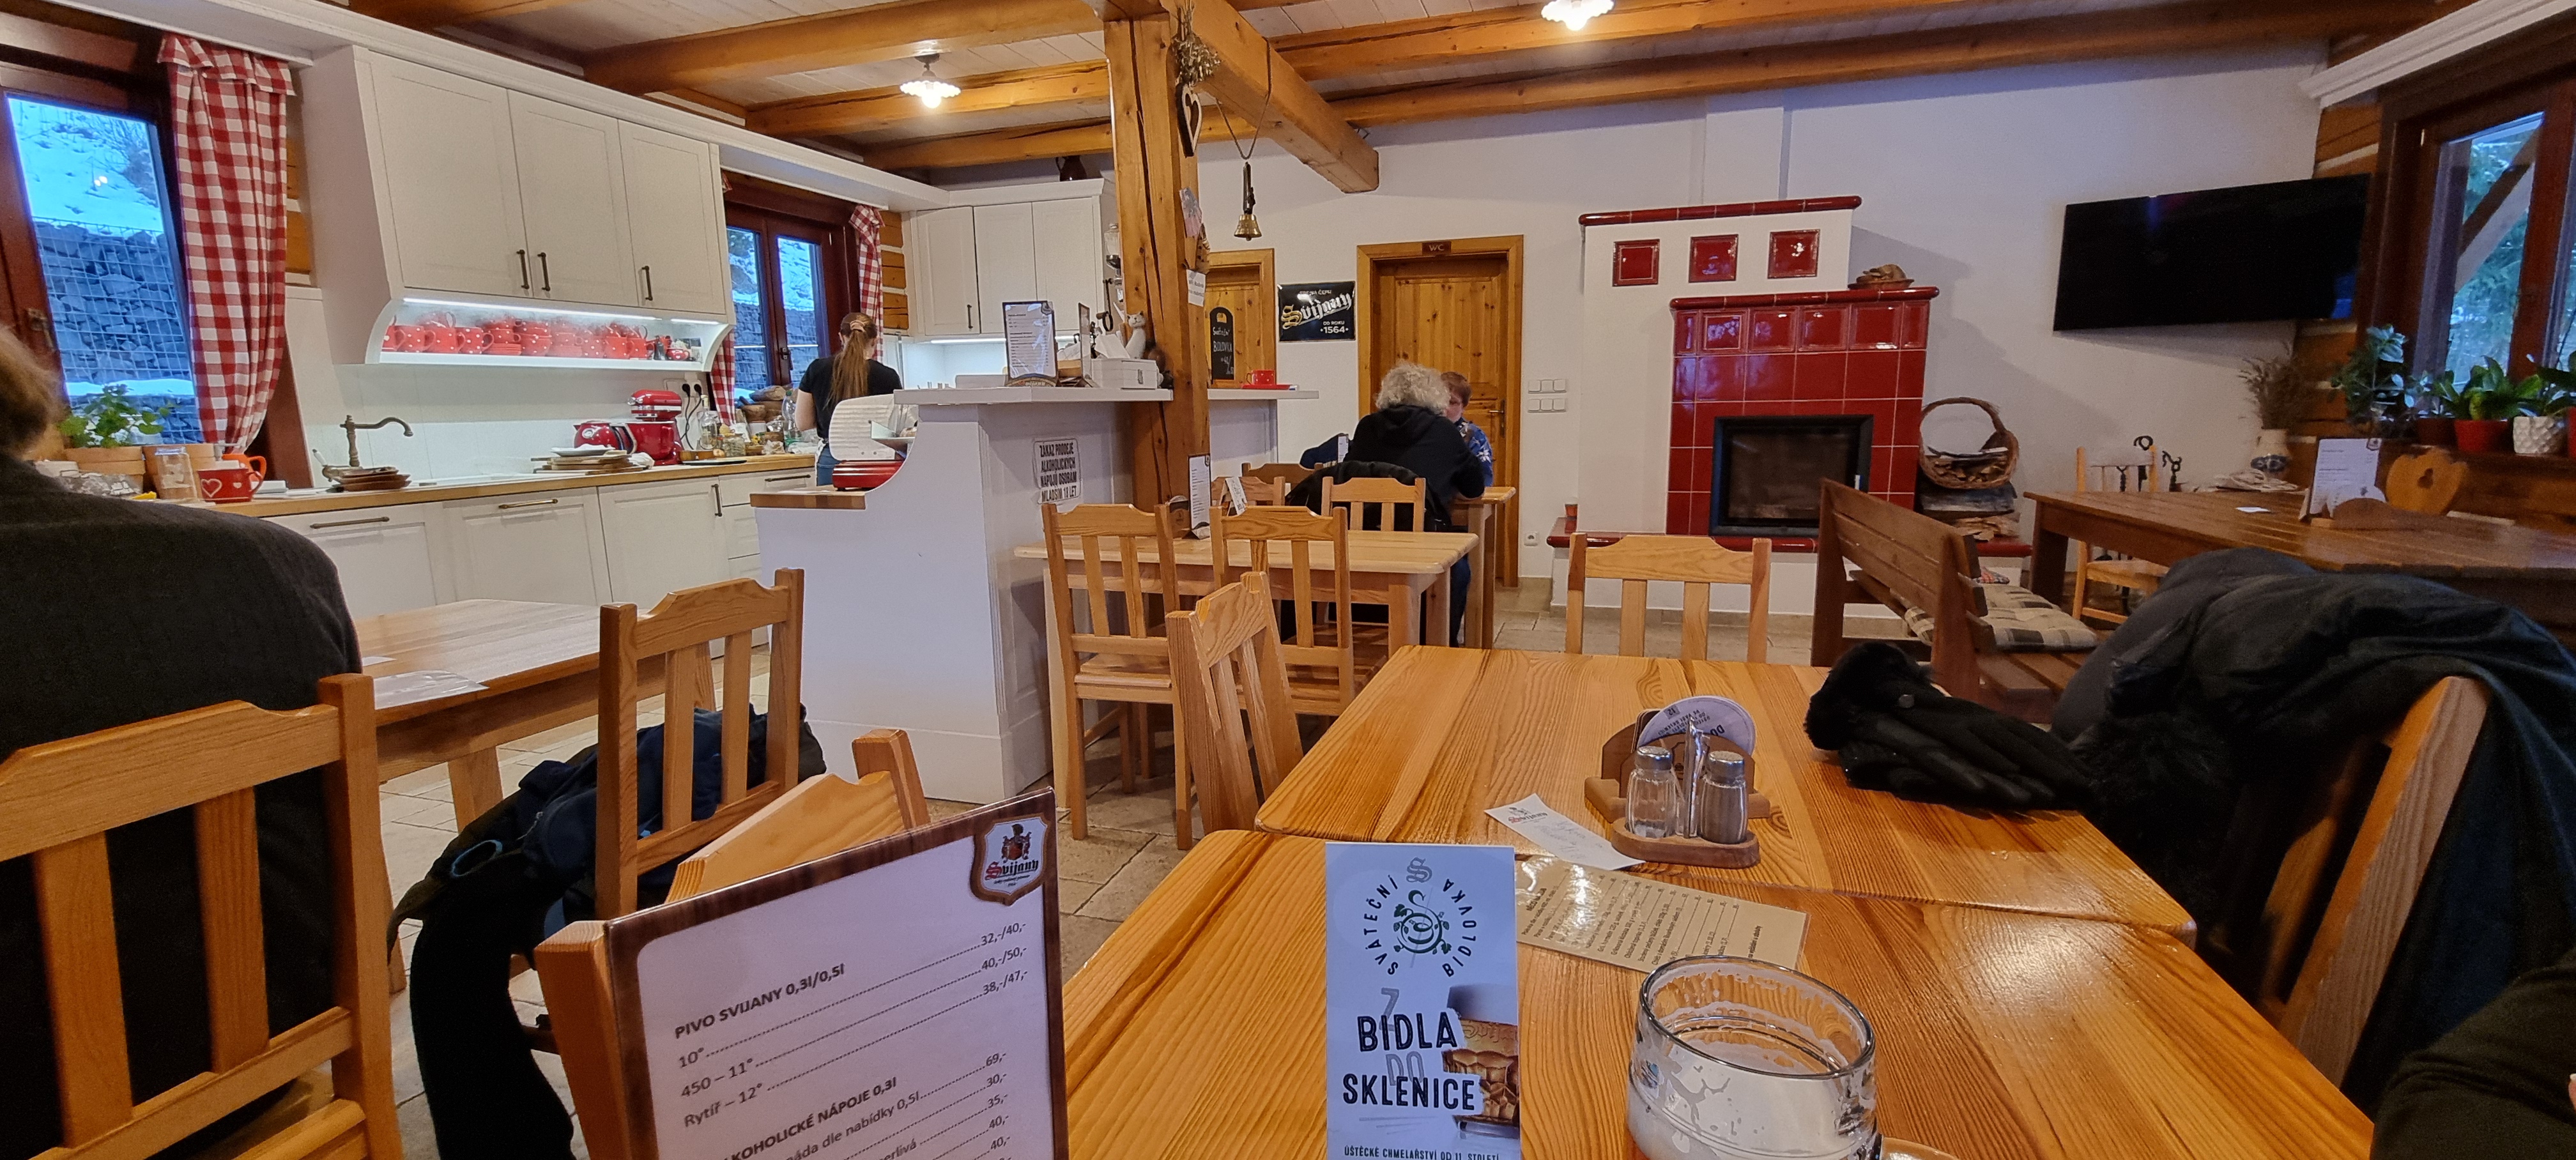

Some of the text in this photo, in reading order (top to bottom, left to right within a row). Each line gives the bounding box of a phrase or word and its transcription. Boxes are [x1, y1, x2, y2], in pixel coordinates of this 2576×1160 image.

[1281, 293, 1352, 330] Svijany
[1039, 441, 1074, 457] ZÁKAZ PRODEJE
[985, 860, 1039, 880] Svijany
[1364, 874, 1478, 977] SVÁTEČNÍ BIDLOVKA
[675, 1014, 715, 1039] PIVO
[719, 987, 783, 1022] SVIJANY
[1357, 1012, 1457, 1052] BIDLA
[678, 1047, 705, 1069] 10°
[1385, 1051, 1425, 1087] DO
[680, 1077, 711, 1097] 450
[728, 1058, 754, 1080] 11°
[1342, 1073, 1475, 1111] SKLENICE
[684, 1101, 721, 1127] Rytíř
[739, 1083, 763, 1104] 12°
[818, 1089, 871, 1123] NÁPOJE
[822, 1132, 843, 1148] dle
[846, 1104, 894, 1136] nabídky
[1344, 1145, 1380, 1158] ÚŠTĚCKÉ
[1441, 1151, 1452, 1160] OD
